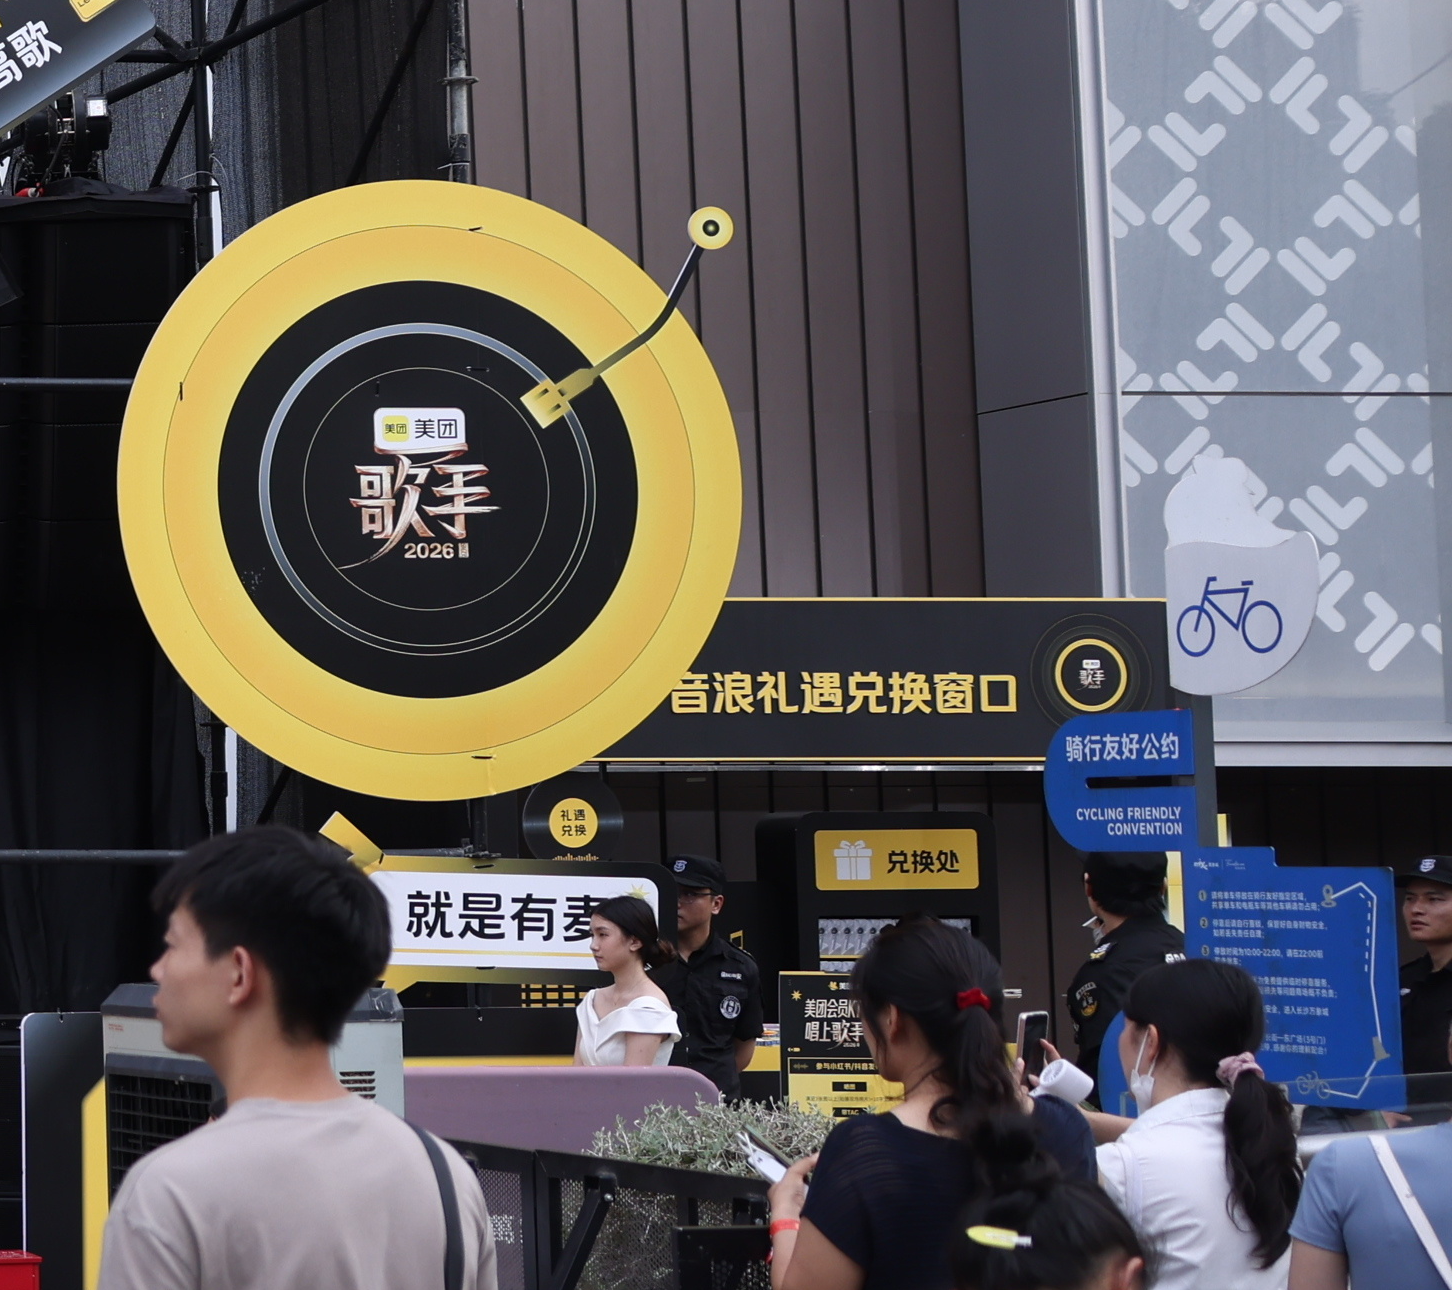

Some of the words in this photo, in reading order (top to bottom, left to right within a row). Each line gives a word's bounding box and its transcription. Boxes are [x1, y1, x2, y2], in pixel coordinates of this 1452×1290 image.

[383, 422, 408, 435] 美团
[413, 417, 458, 439] 美团
[341, 451, 502, 557] 歌手
[403, 542, 455, 560] 2026
[668, 669, 1018, 716] 音浪礼遇兑换窗口
[1065, 733, 1180, 762] 骑行友好公约
[560, 809, 586, 822] 礼遇
[1076, 808, 1124, 821] CYCLING
[1127, 807, 1181, 820] FRIENDLY
[560, 823, 587, 837] 兑换
[1107, 822, 1183, 835] CONVENTION
[887, 850, 960, 874] 兑换处
[406, 890, 609, 943] 就是有麦
